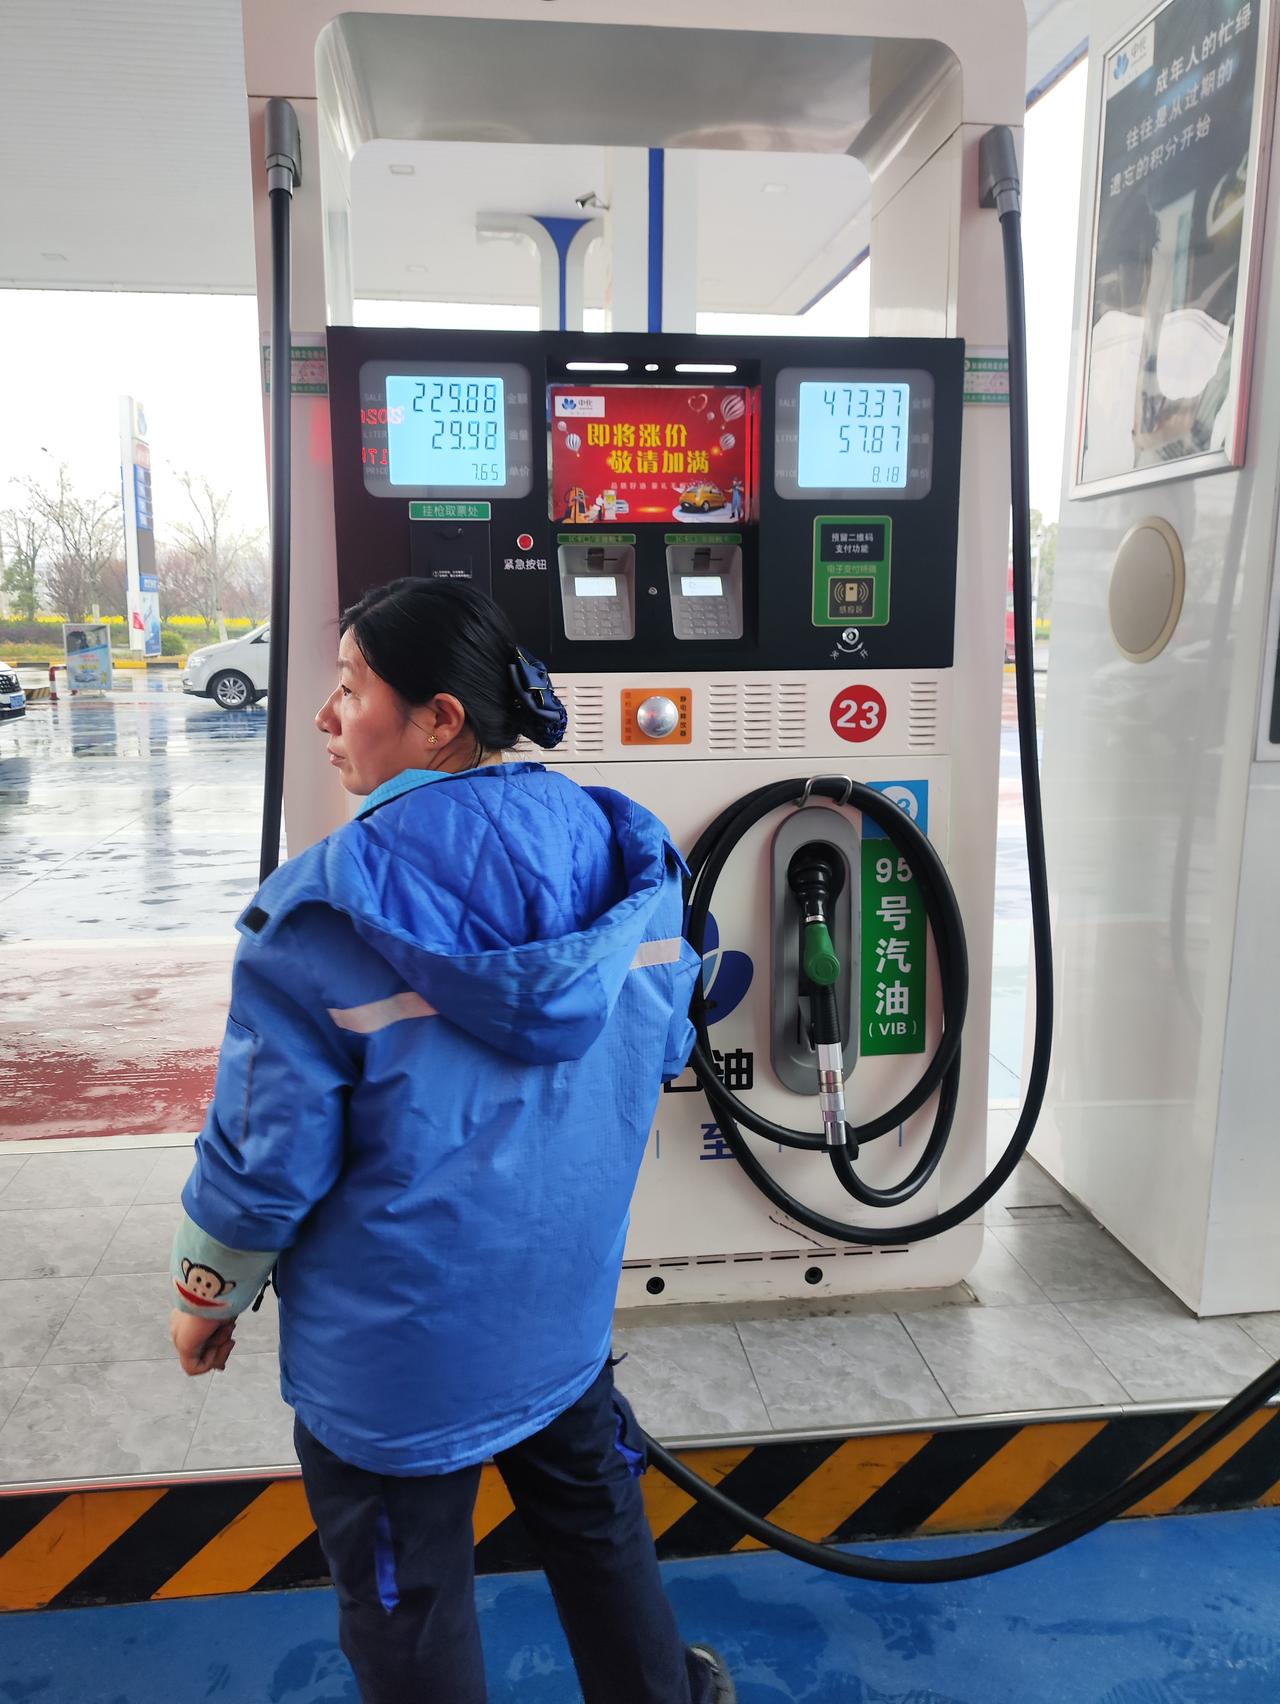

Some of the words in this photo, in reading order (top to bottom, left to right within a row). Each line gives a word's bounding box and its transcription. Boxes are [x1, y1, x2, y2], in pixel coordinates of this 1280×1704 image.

[1125, 57, 1233, 152] 往往是从过期的
[1109, 112, 1211, 197] 遗忘的积分开始
[823, 389, 902, 418] 473.37
[586, 422, 689, 448] 即将涨价
[838, 425, 902, 454] 57.87
[471, 463, 499, 481] 7.65
[609, 449, 710, 475] 敬请加满
[872, 465, 900, 484] 8.18
[422, 504, 480, 518] 挂枪取票处
[831, 532, 874, 543] 预留二维码
[835, 544, 870, 555] 支付功能
[503, 558, 548, 572] 紧急按钮
[836, 699, 881, 731] 23
[699, 1122, 737, 1161] 至
